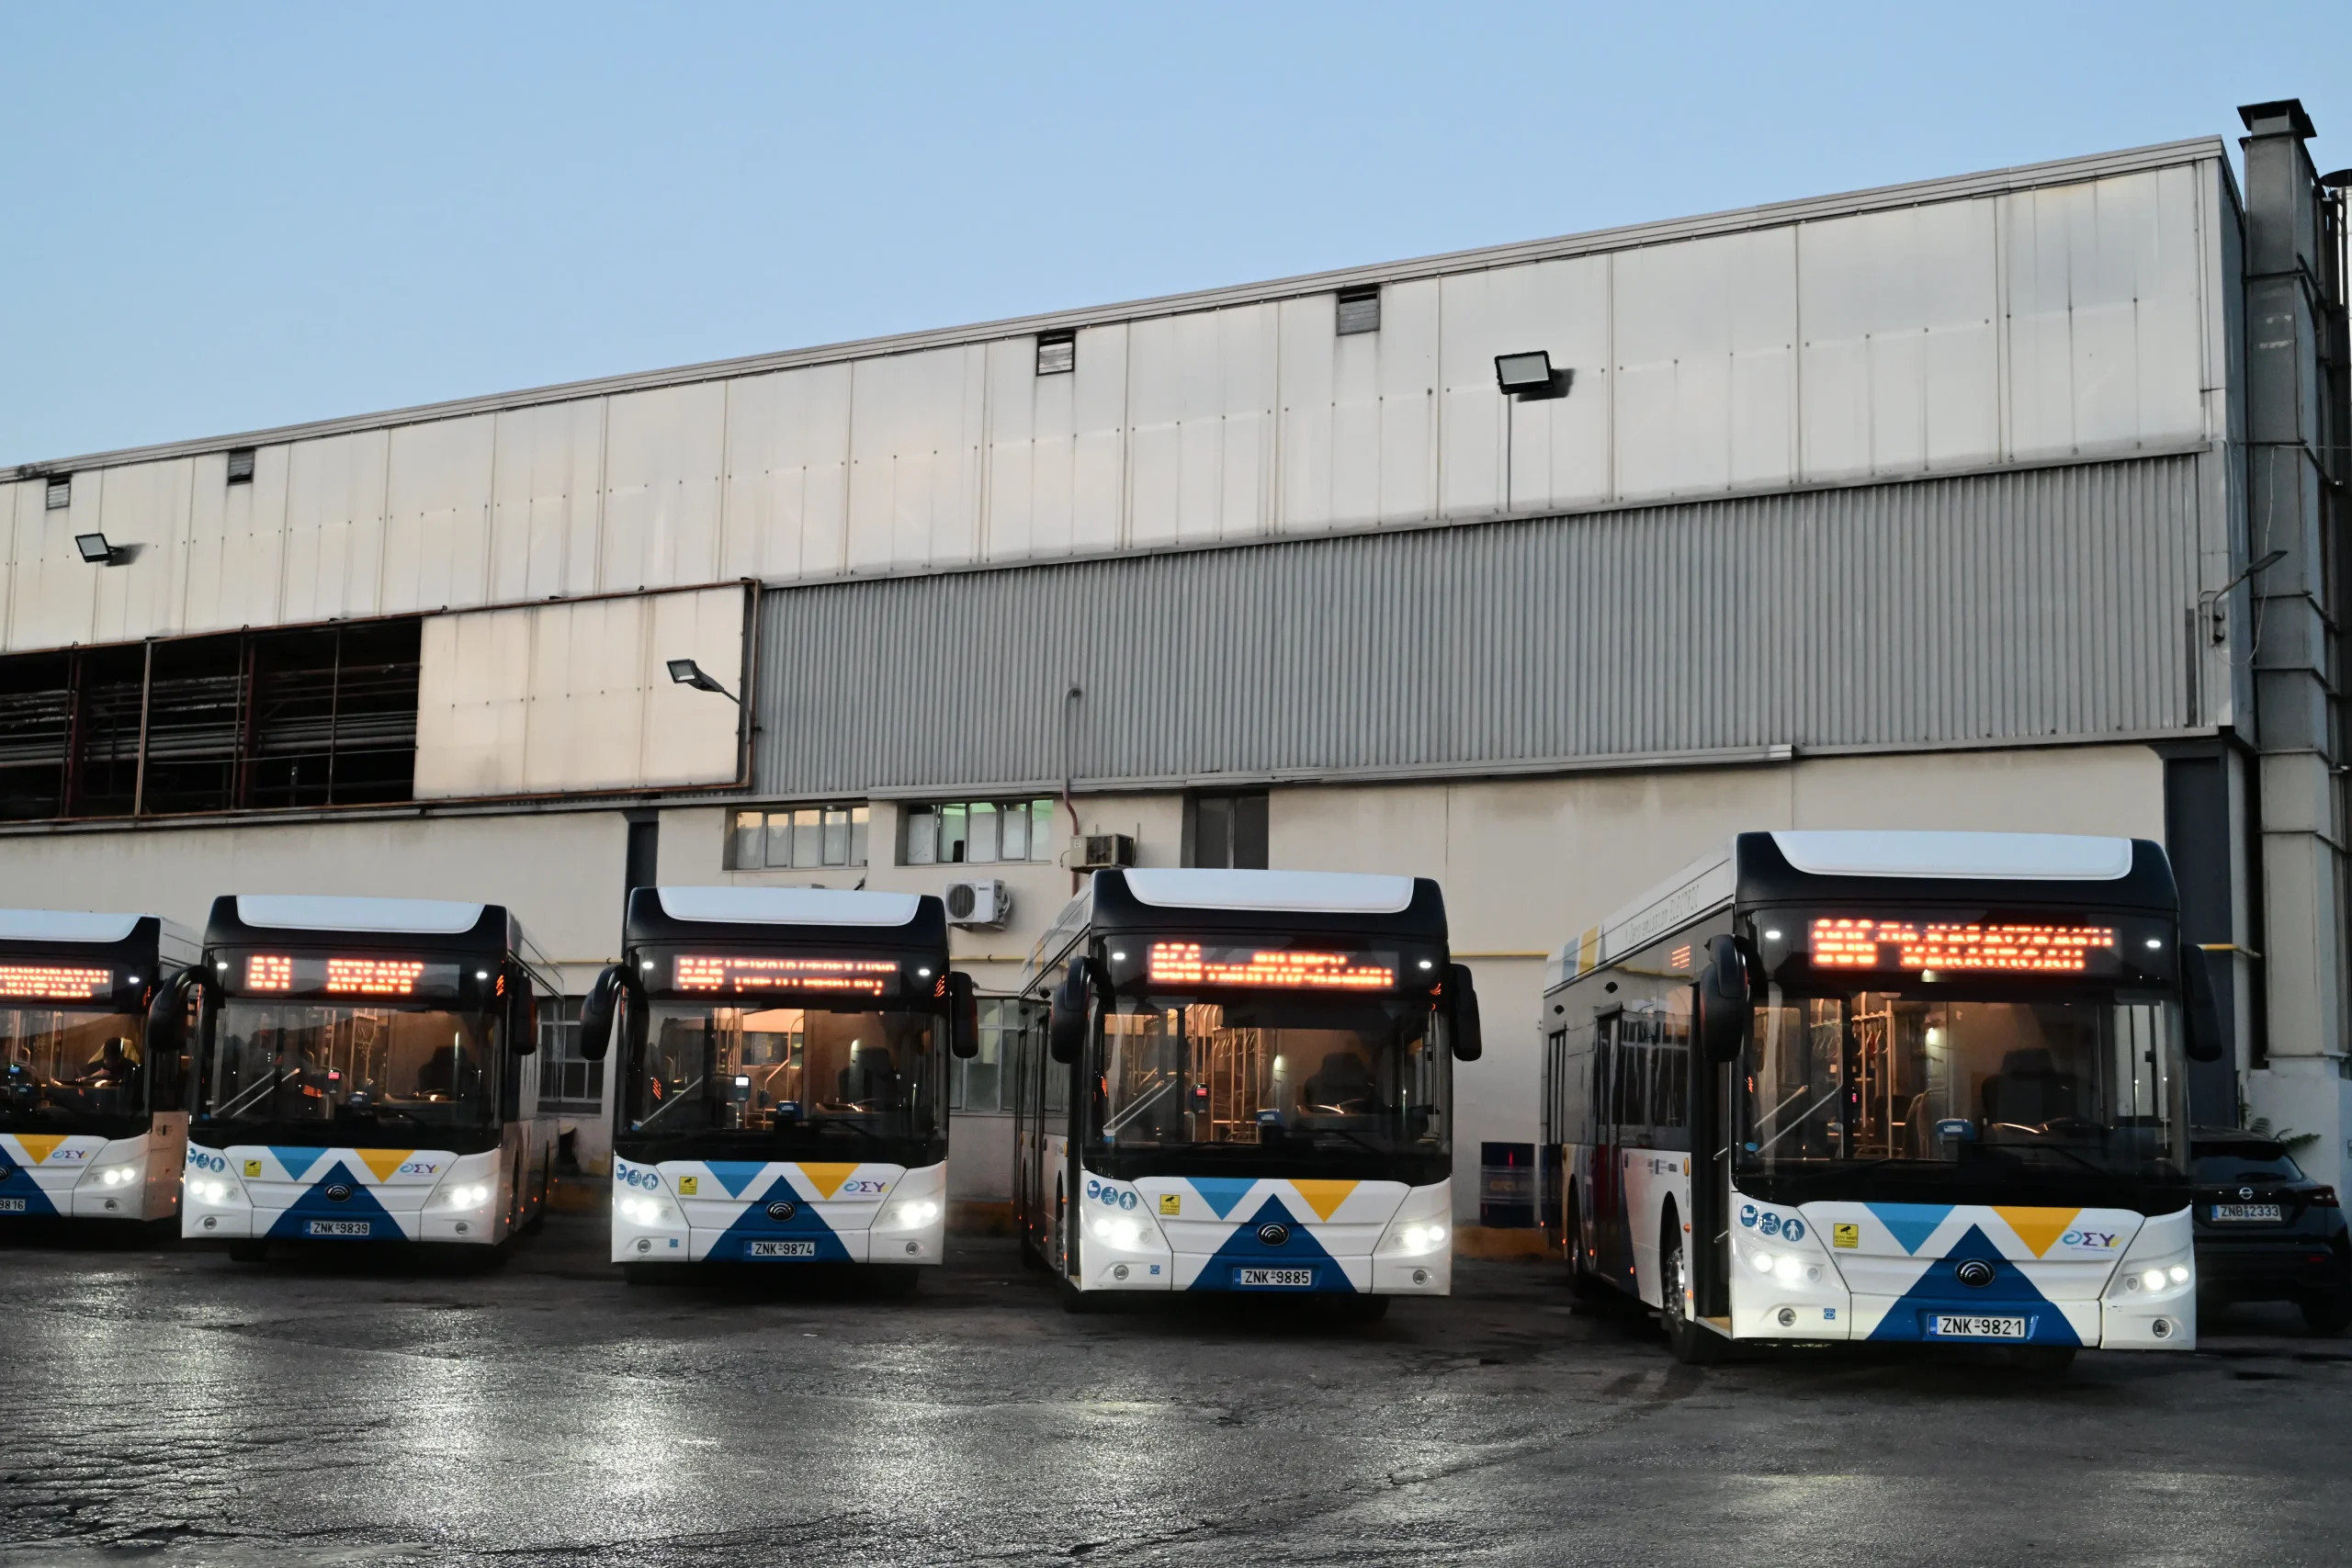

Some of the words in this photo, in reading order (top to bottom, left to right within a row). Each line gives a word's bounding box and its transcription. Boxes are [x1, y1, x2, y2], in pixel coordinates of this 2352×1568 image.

[313, 1223, 368, 1235] ZNK-9839
[754, 1243, 813, 1256] ZNK-9874
[1245, 1270, 1309, 1285] ZNK-9885
[1942, 1317, 2021, 1337] ZNK-9821
